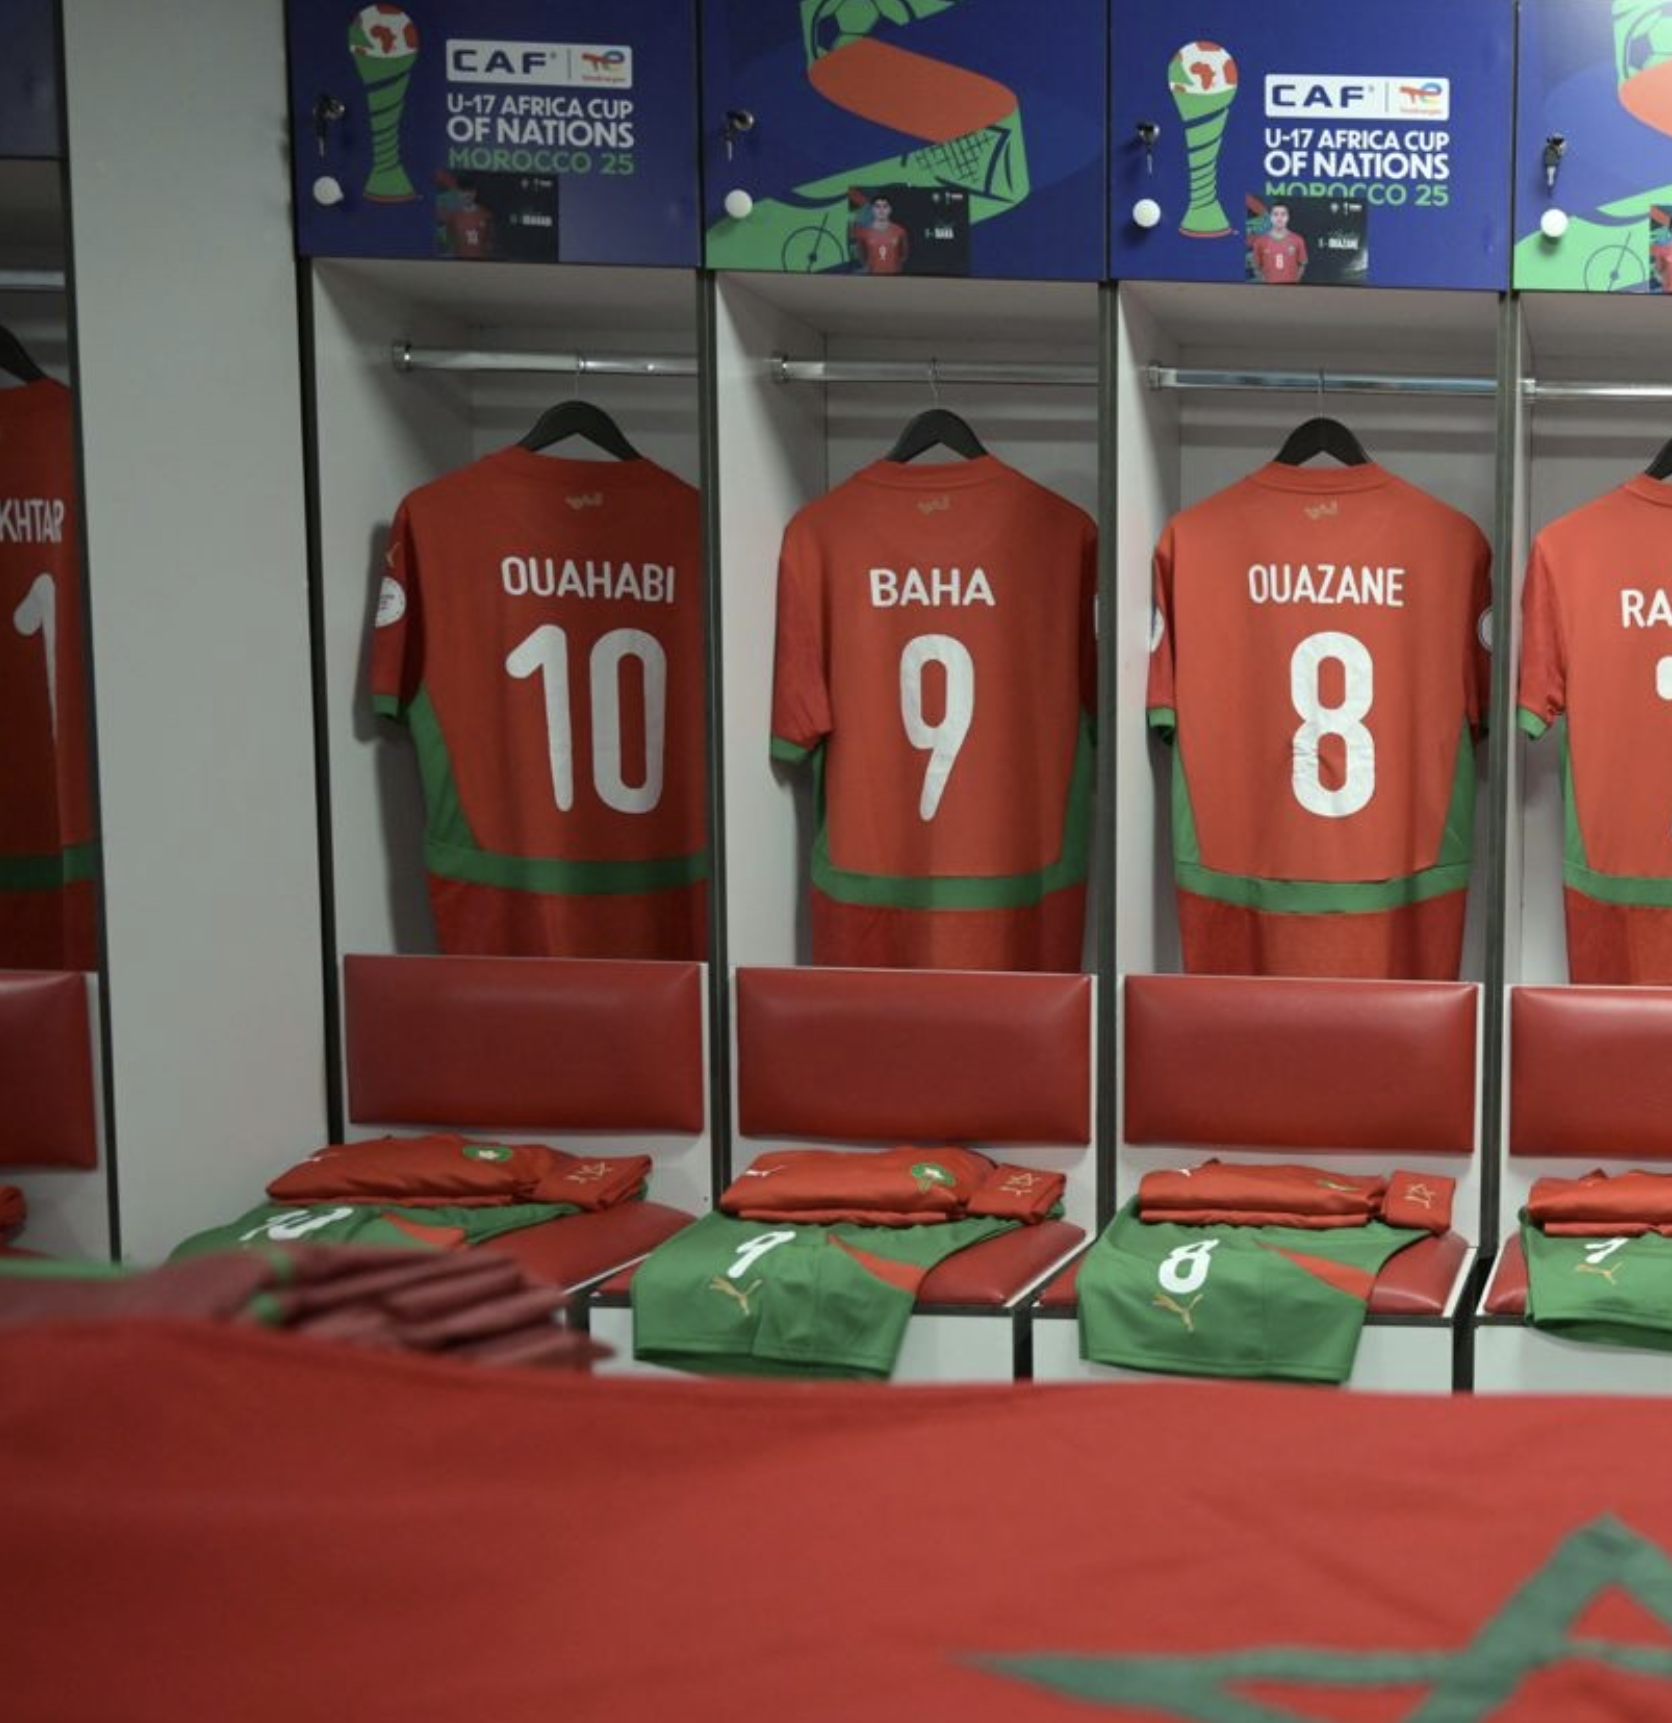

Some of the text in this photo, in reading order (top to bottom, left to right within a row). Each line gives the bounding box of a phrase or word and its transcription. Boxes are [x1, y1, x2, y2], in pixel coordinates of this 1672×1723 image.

[453, 49, 547, 74] CAF
[448, 93, 633, 119] U-17 AFRICA CUP
[1272, 85, 1364, 107] CAF
[447, 115, 635, 148] OF NATIONS
[1265, 128, 1449, 151] U-17 AFRICA CUP
[448, 148, 634, 175] MOROCCO 25
[1264, 150, 1449, 179] OF NATIONS
[1415, 184, 1449, 206] 25
[501, 556, 675, 603] OUAHABI
[869, 567, 996, 607] BAHA
[1249, 564, 1405, 607] OUAZANE
[505, 624, 667, 814] 10
[900, 634, 975, 822] 9
[1290, 631, 1375, 818] 8
[727, 1231, 796, 1278] 9
[1158, 1238, 1220, 1293] 8
